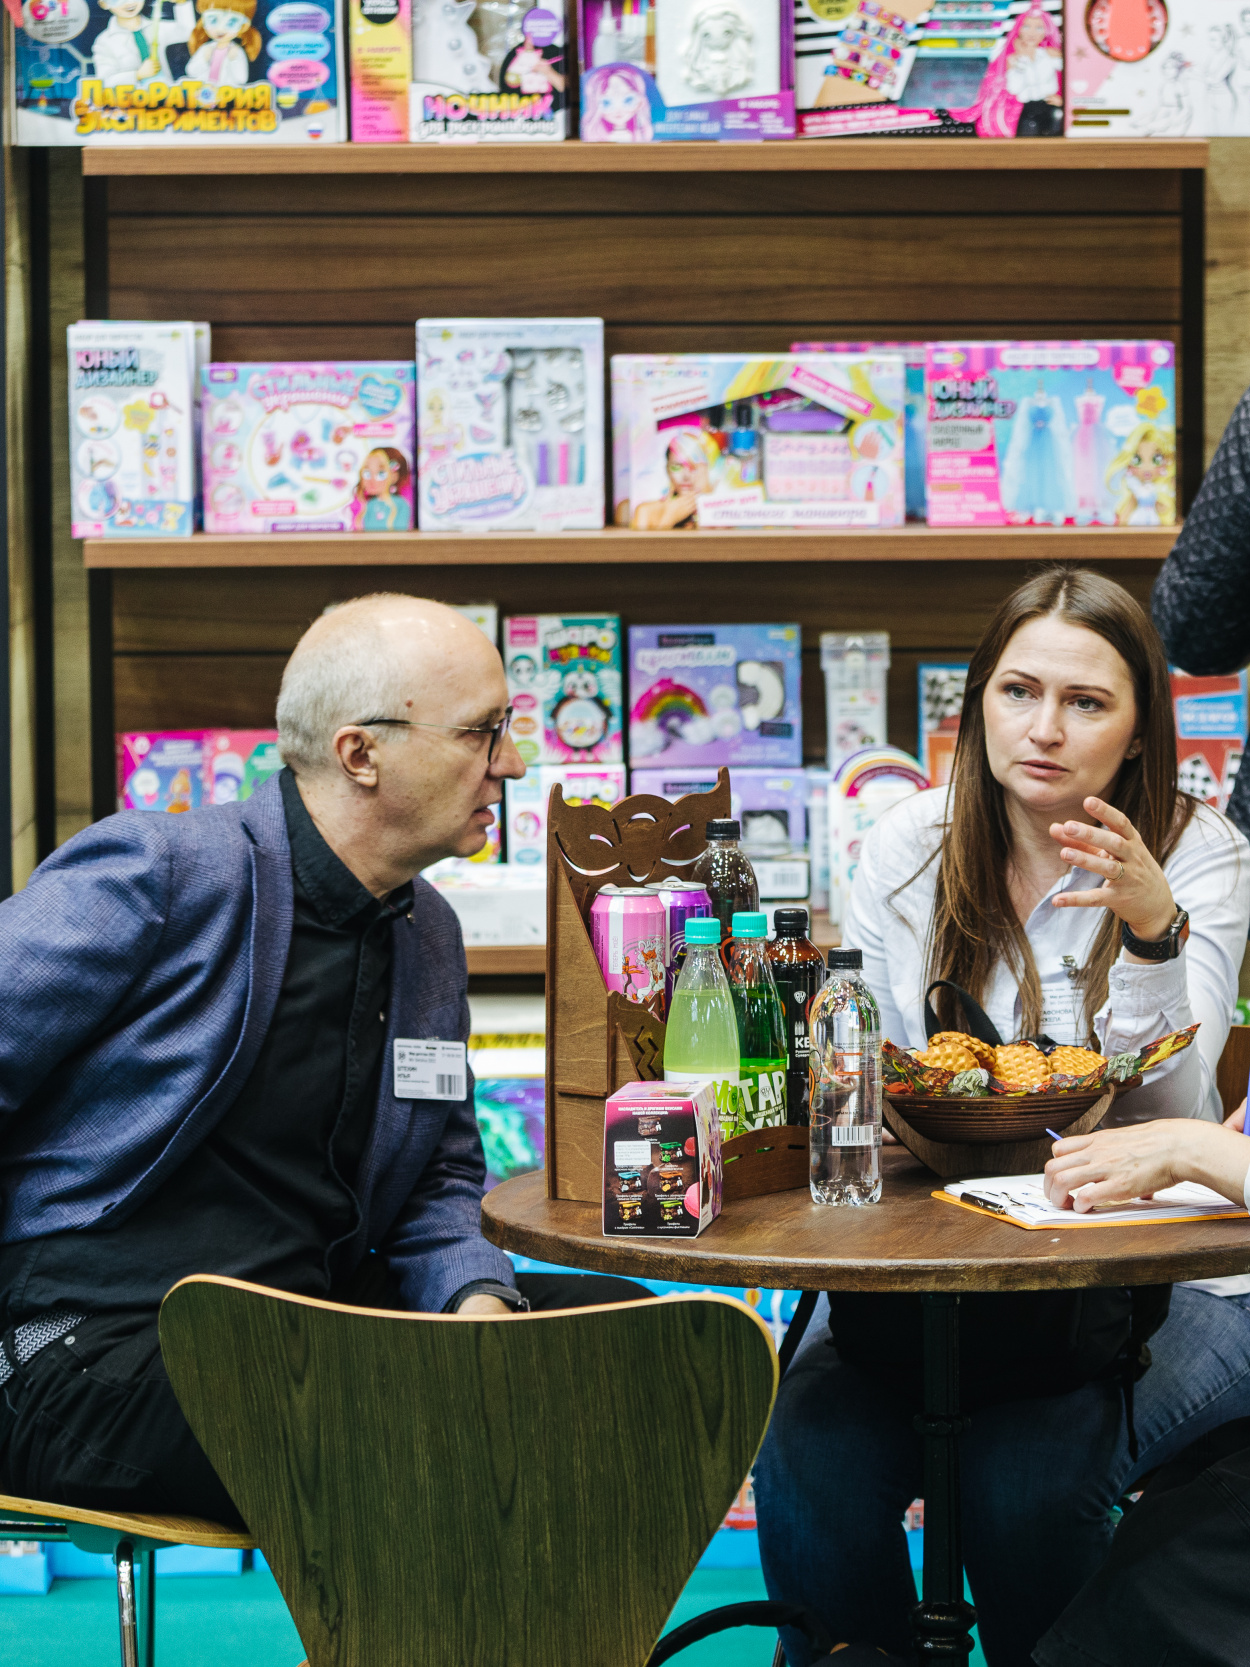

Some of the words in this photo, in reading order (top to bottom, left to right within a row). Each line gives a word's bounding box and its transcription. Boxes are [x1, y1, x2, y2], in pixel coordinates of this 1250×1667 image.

[423, 93, 554, 121] НОЧНИК
[76, 348, 139, 370] ЮНЫЙ
[75, 369, 159, 388] ДИЗАЙНЕР
[932, 378, 997, 401] ЮНЫЙ
[932, 400, 1017, 420] ДИЗАЙНЕР
